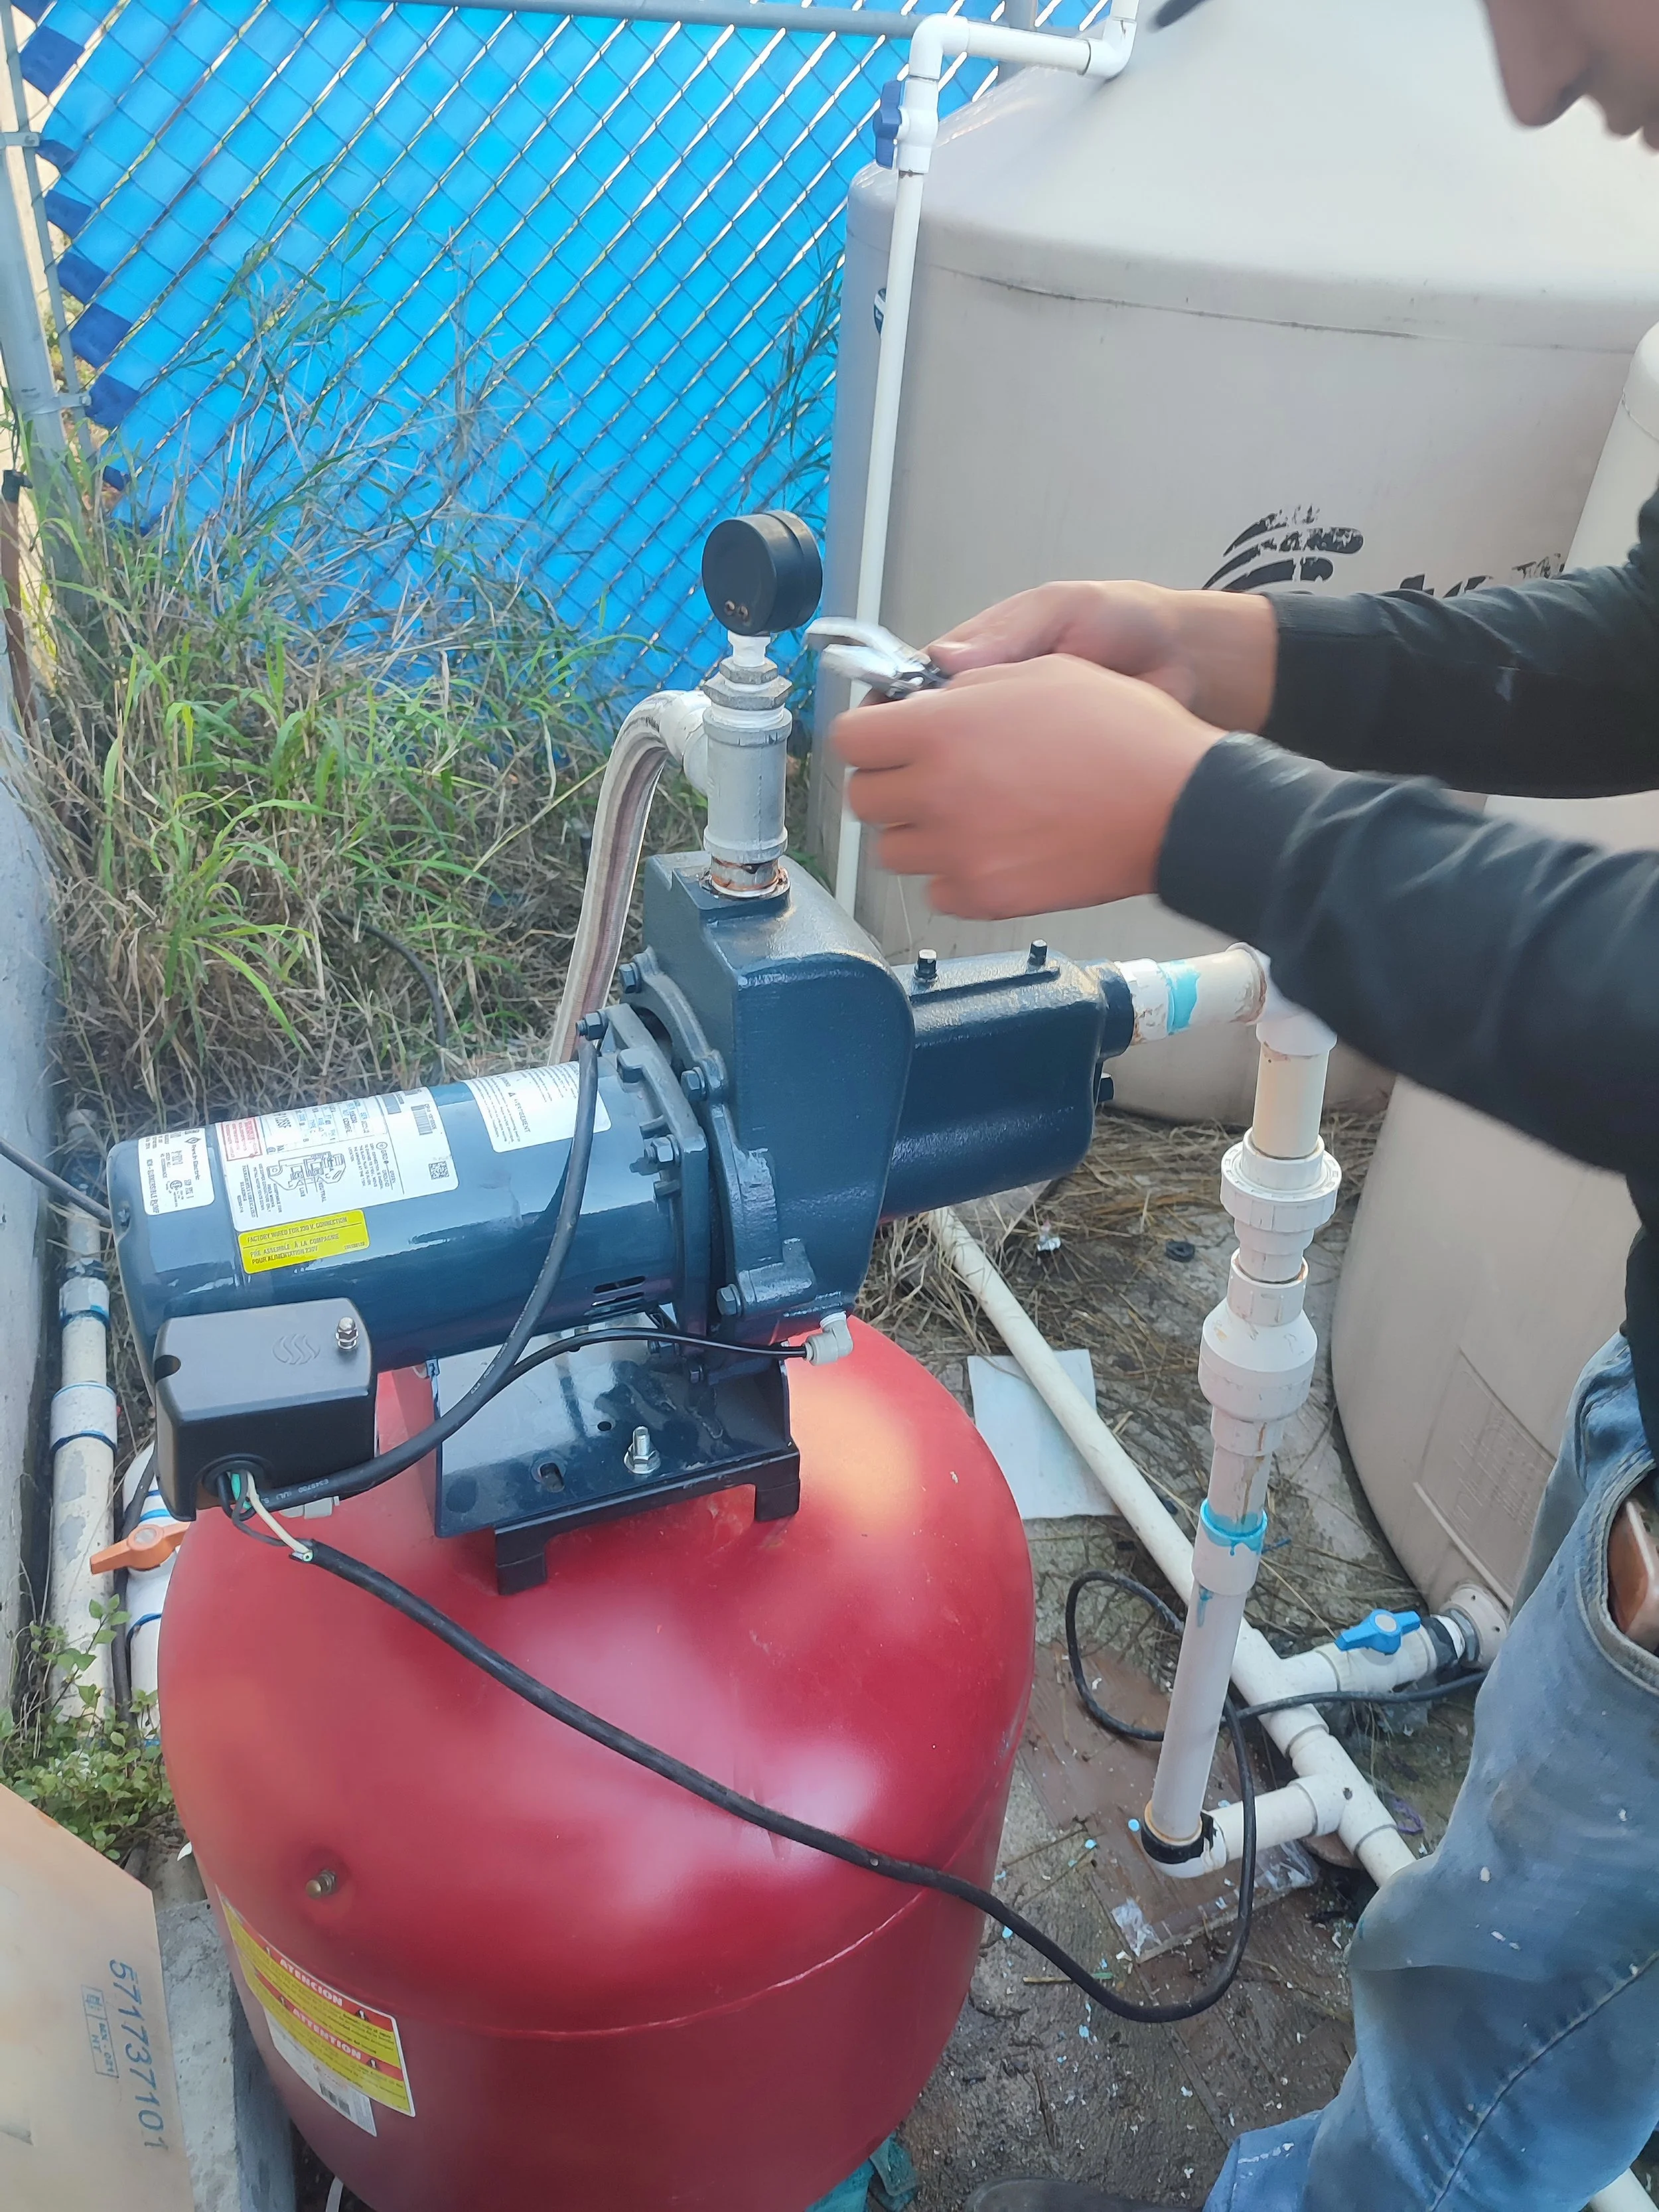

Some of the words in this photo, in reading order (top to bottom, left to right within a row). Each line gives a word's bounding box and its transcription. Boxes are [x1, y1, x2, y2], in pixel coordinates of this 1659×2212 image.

[192, 1160, 201, 1181] Electric
[317, 1181, 326, 1203] NEUTRAL
[149, 1199, 160, 1214] PUMP
[246, 1232, 270, 1243] FACTORY
[270, 1229, 289, 1238] WIRED
[315, 1216, 348, 1228] CONNECTION
[251, 1255, 267, 1265] POUR
[267, 1248, 305, 1262] ALIMENTATION
[304, 1245, 319, 1254] 230V
[279, 1957, 343, 2007] ATENCION
[90, 2033, 102, 2054] NT
[291, 2008, 362, 2061] ATTENTION
[109, 1958, 169, 2150] 571737101
